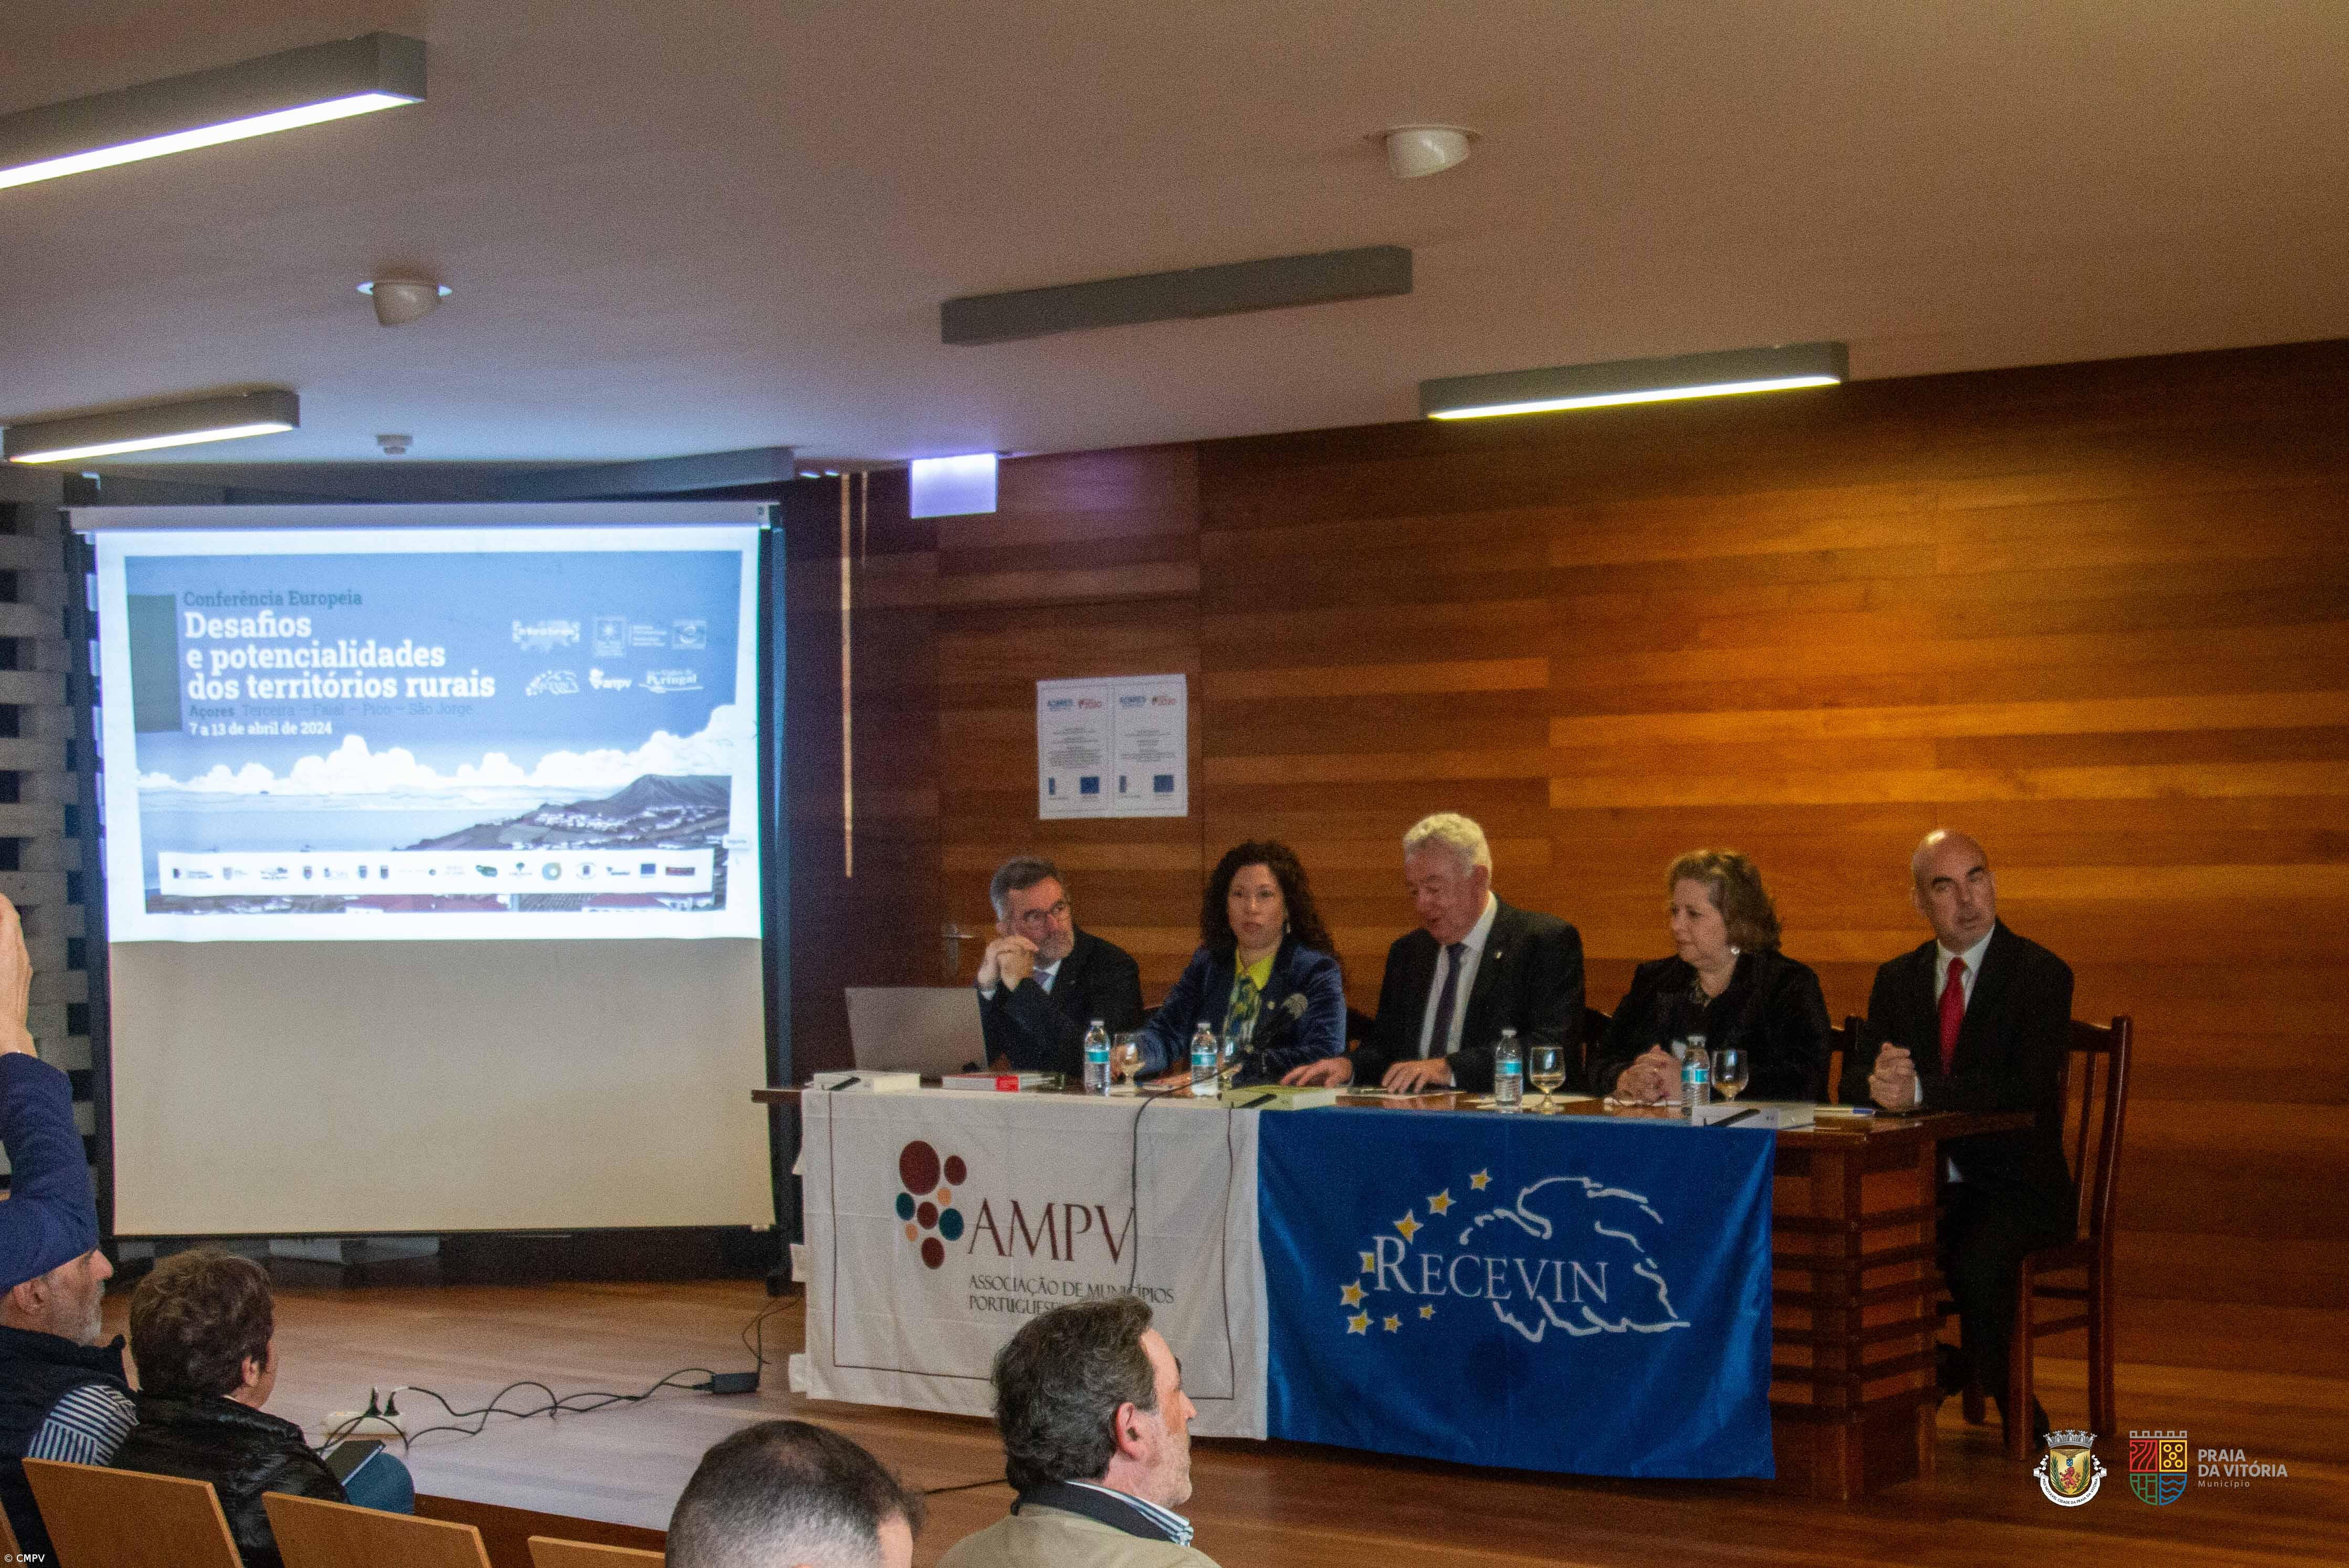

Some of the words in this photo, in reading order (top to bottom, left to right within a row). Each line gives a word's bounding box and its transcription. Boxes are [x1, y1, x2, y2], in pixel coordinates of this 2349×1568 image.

[184, 590, 284, 606] Conferência
[289, 589, 362, 609] Europeia
[185, 609, 312, 638] Desafios
[186, 648, 203, 669] e
[210, 639, 445, 676] potencialidades
[188, 672, 240, 700] dos
[247, 670, 398, 699] territórios
[405, 669, 496, 698] rurais
[189, 704, 236, 719] Açores
[189, 722, 198, 735] 7
[200, 724, 209, 736] a
[211, 723, 227, 736] 13
[229, 722, 245, 735] de
[247, 721, 279, 735] abril
[281, 721, 298, 735] de
[301, 721, 333, 735] 2024
[968, 1198, 1135, 1265] AMPV
[1373, 1234, 1609, 1304] RECEVIN
[969, 1274, 1059, 1296] ASSOCIAÇÃO
[1062, 1281, 1084, 1298] DE
